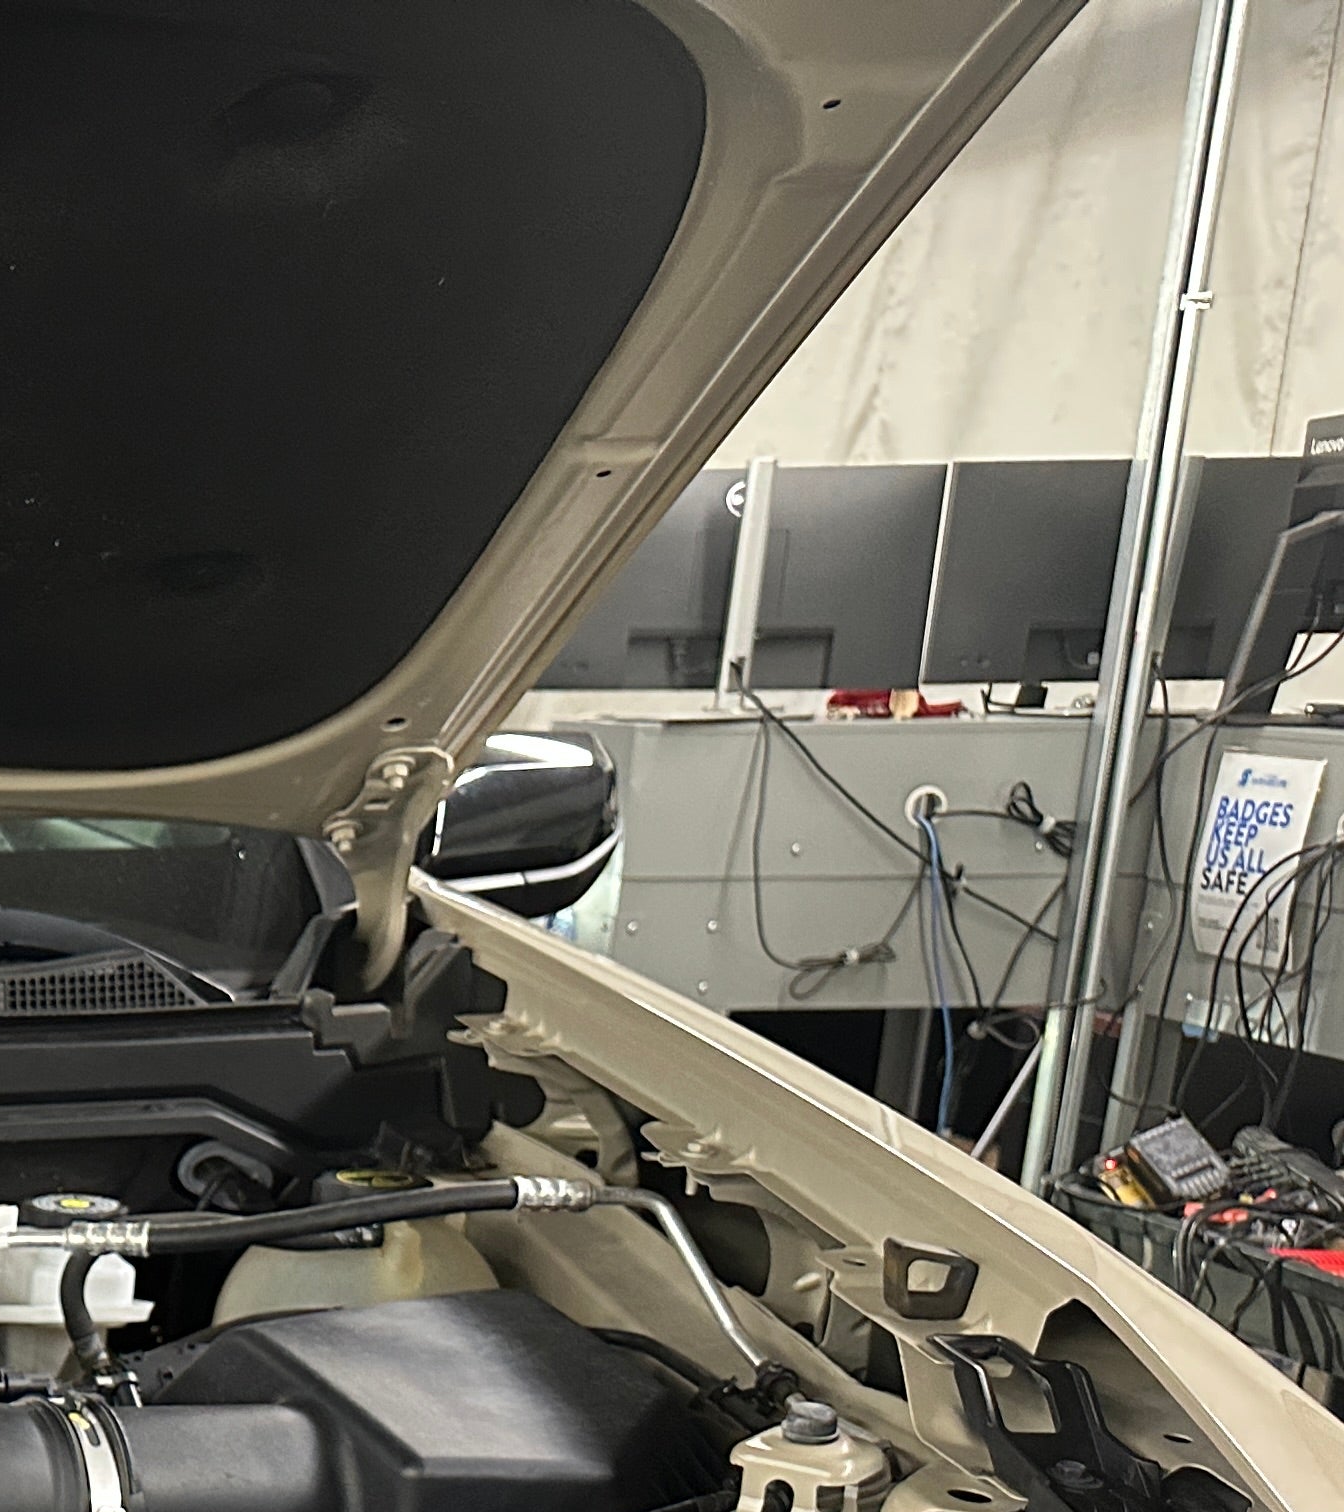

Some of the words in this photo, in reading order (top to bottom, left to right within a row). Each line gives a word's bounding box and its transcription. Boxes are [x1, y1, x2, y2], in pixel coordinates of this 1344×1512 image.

[1216, 796, 1295, 829] BADGES
[1211, 819, 1259, 848] KEEP
[1205, 845, 1230, 869] US
[1234, 848, 1266, 874] ALL
[1200, 869, 1249, 896] SAFE
